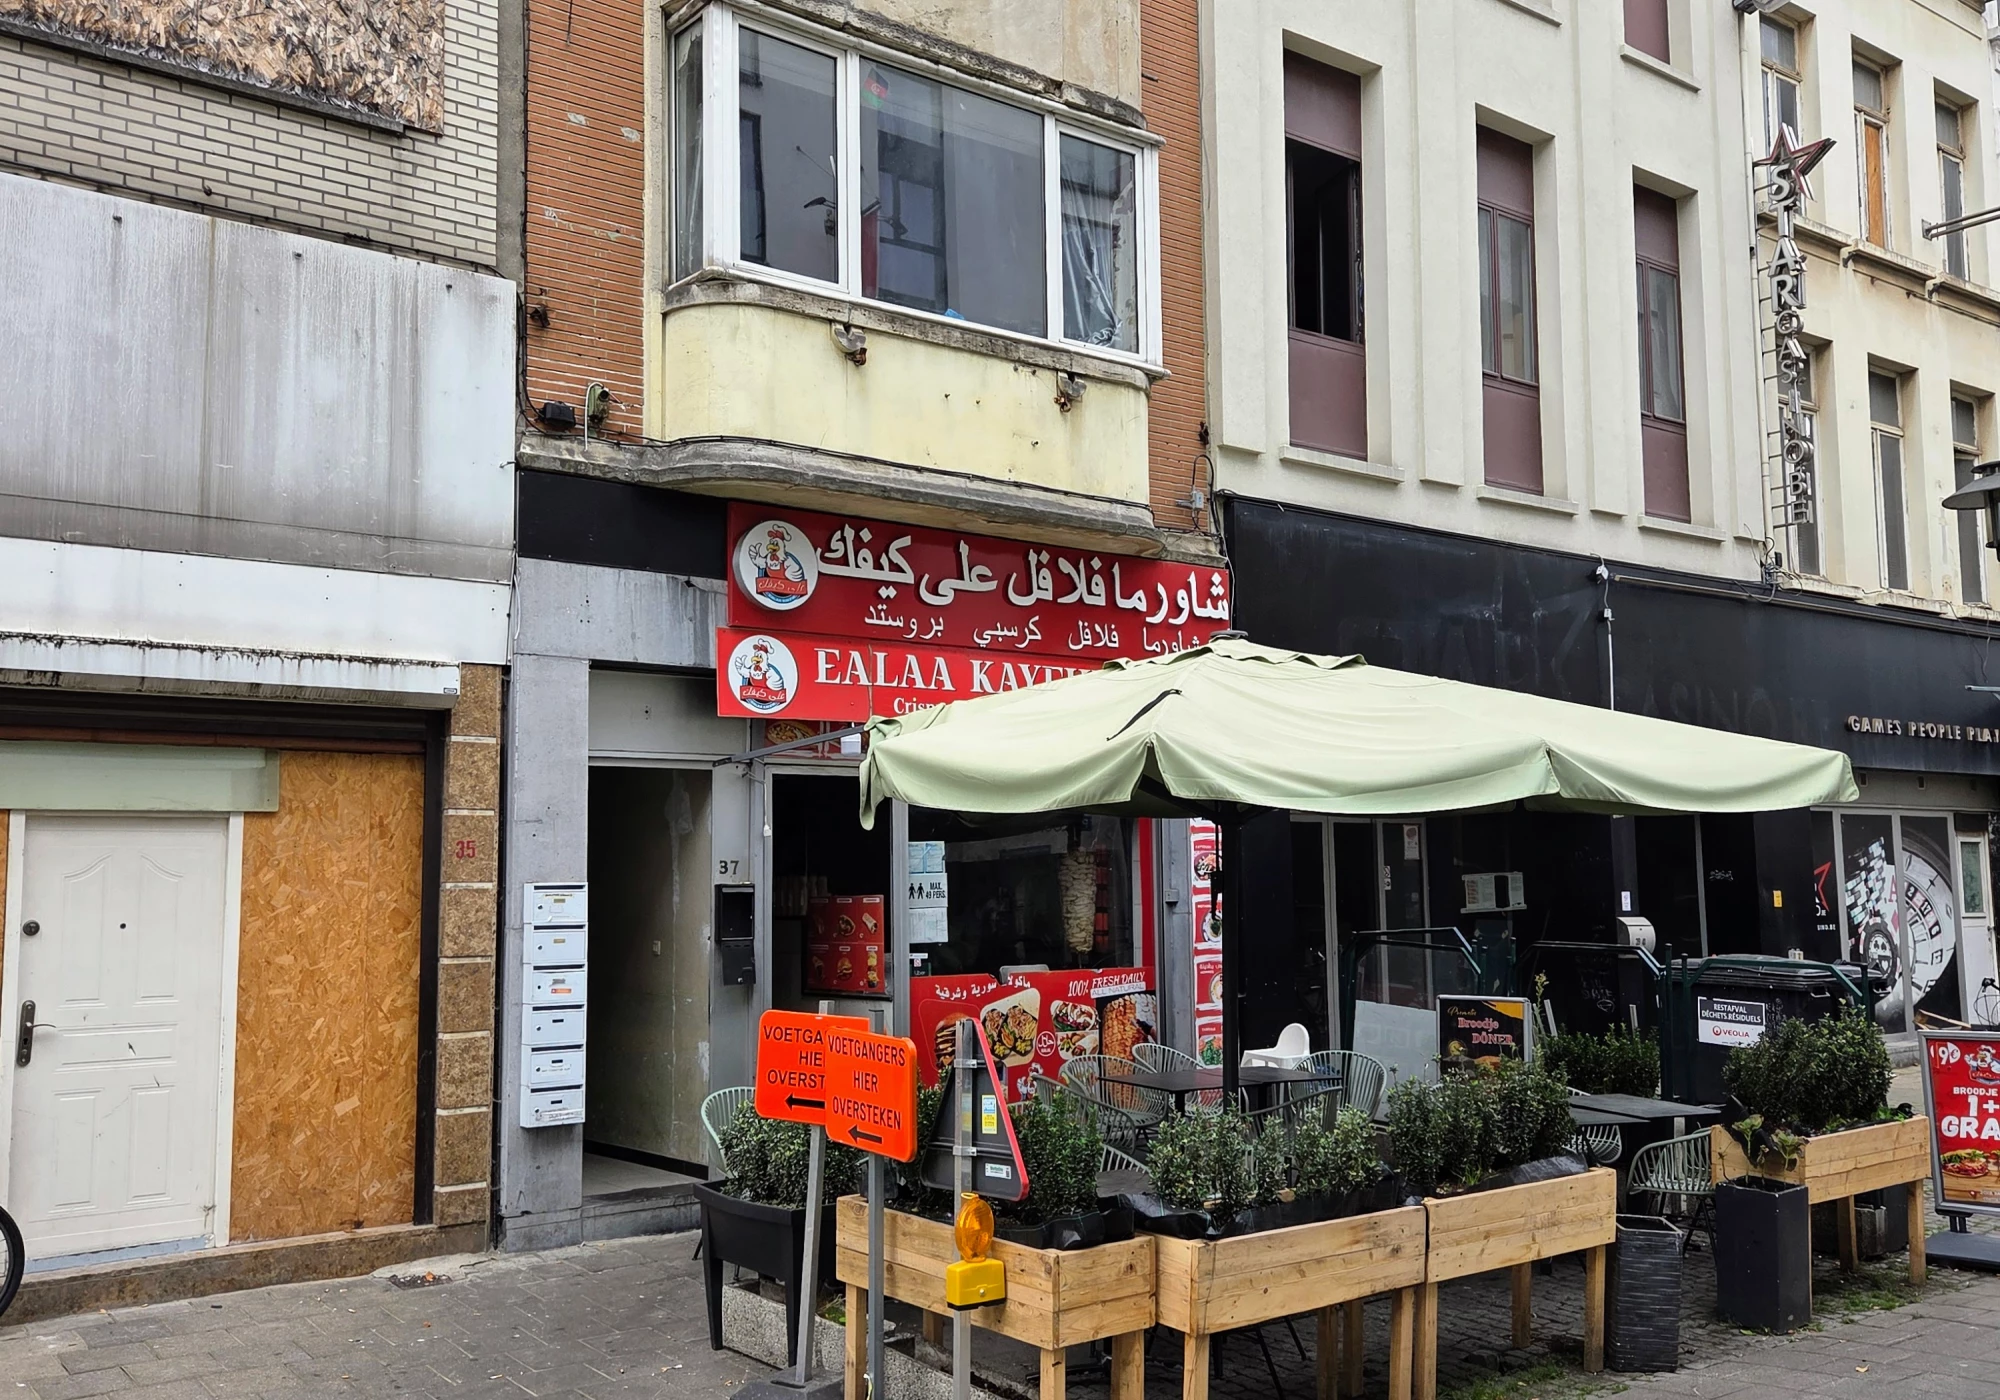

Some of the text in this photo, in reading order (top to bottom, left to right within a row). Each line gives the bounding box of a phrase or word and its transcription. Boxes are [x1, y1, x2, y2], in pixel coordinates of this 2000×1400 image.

[816, 524, 1229, 625] شاورما فلافل على كيفك
[864, 603, 944, 639] بروستد
[973, 616, 1042, 648] كرسبي
[1068, 620, 1119, 651] فلافل
[814, 647, 956, 691] EALAA
[1848, 715, 1902, 736] GAMES
[1907, 721, 1962, 740] PEOPLE
[456, 840, 477, 859] 35
[718, 860, 740, 875] 37
[935, 984, 967, 1000] وشرقية
[971, 981, 997, 997] سورية
[1068, 972, 1145, 997] 100% FRESH DAILY
[1092, 983, 1145, 996] ALL NATURAL
[1713, 1003, 1748, 1014] RESTAFVAL
[1457, 1017, 1499, 1032] Broodje
[1722, 1029, 1750, 1038] VEOLIA
[799, 1051, 825, 1068] HIE
[828, 1035, 906, 1067] VOETGANGERS
[853, 1070, 878, 1093] HIER
[1953, 1086, 1998, 1096] BROODJE
[832, 1096, 902, 1130] OVERSTEKEN
